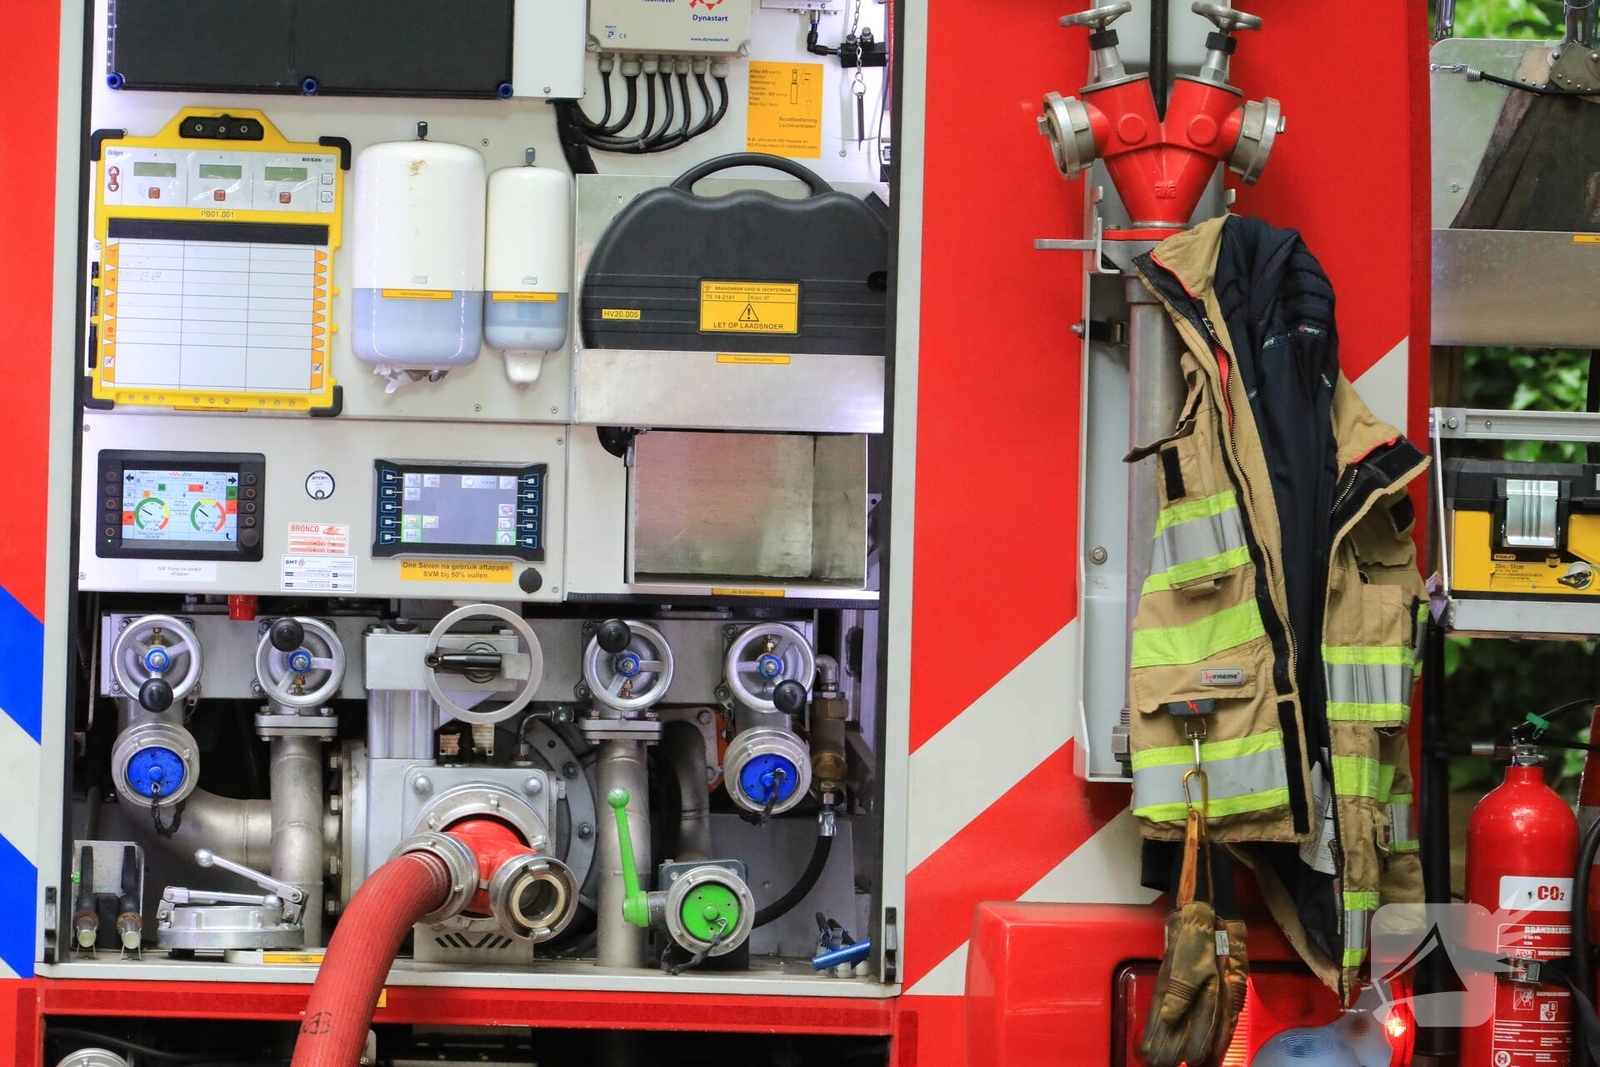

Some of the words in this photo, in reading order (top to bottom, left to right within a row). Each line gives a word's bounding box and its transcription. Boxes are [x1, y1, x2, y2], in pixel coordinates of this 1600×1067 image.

[692, 14, 728, 22] Dynastart
[201, 211, 234, 219] PB01.001
[604, 310, 639, 318] HV20.005
[740, 322, 784, 330] LAADSNOER
[291, 524, 320, 533] BRONCO
[402, 561, 417, 569] One
[451, 563, 477, 571] gebruik
[440, 571, 450, 579] bij
